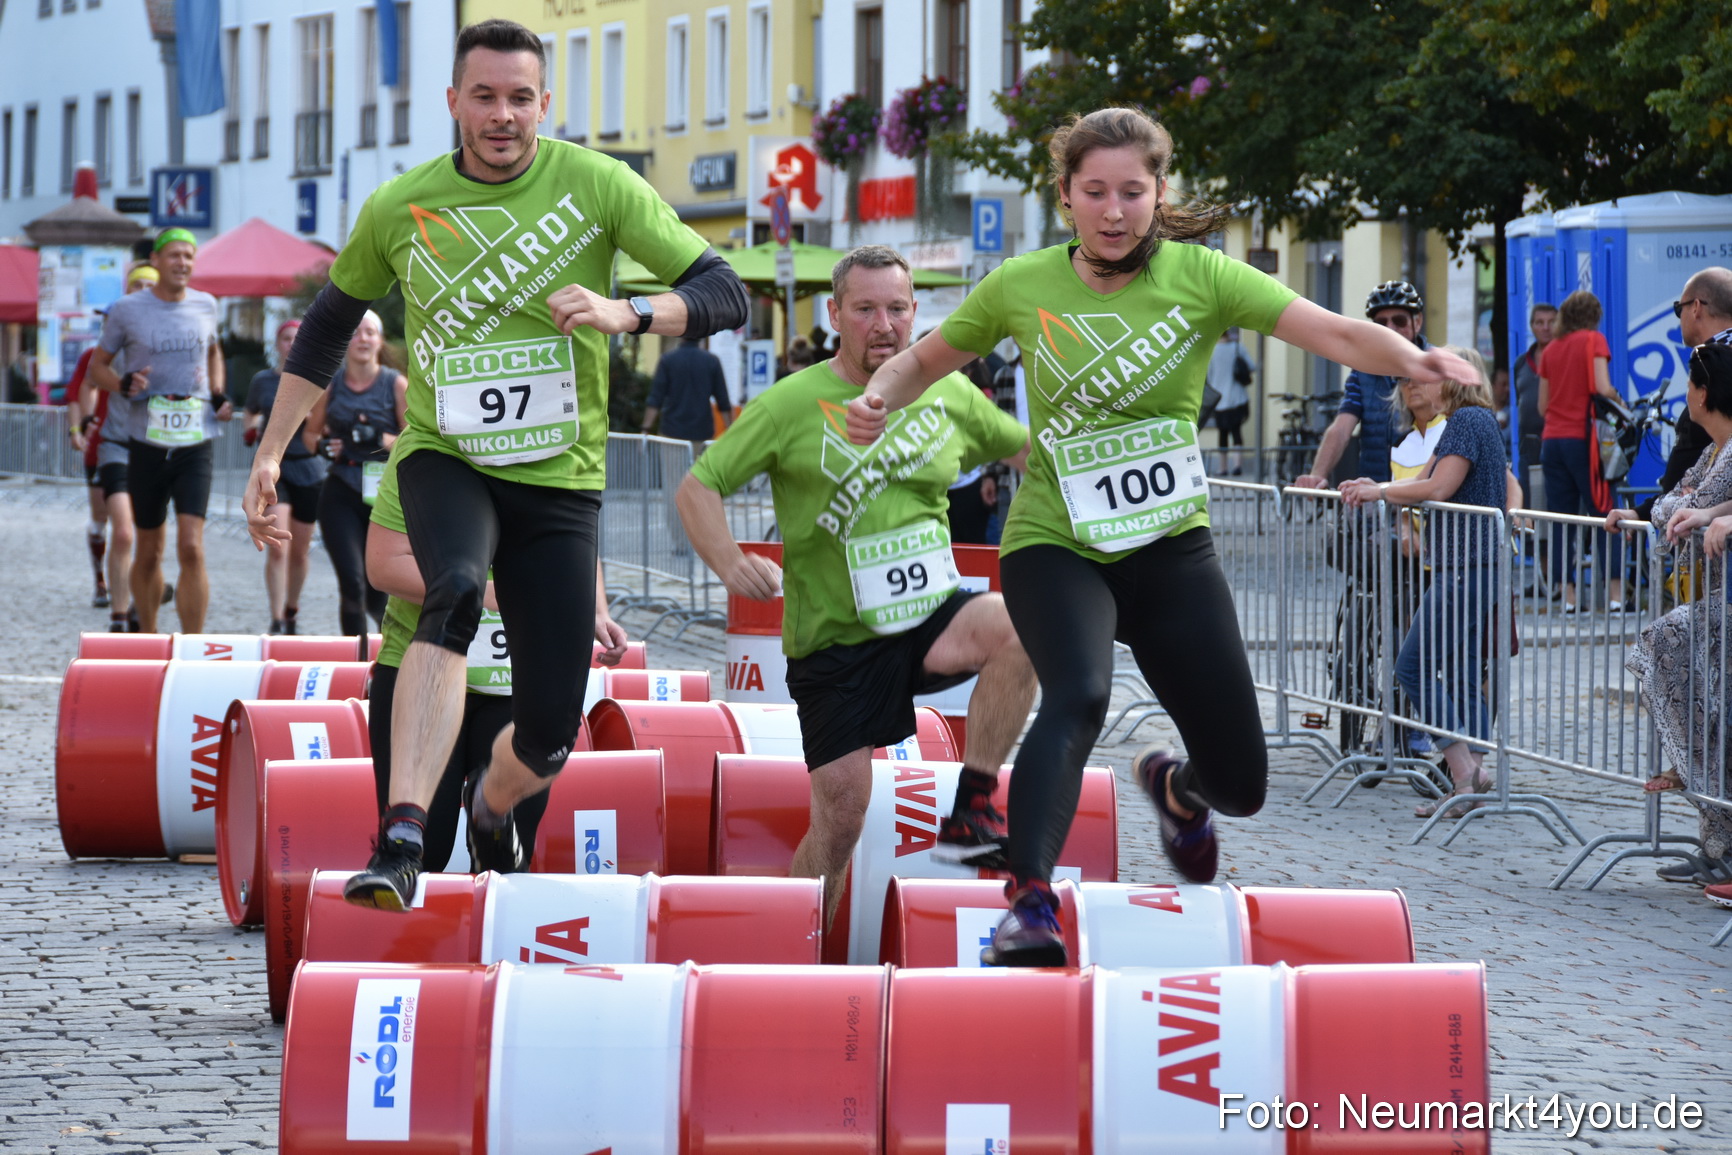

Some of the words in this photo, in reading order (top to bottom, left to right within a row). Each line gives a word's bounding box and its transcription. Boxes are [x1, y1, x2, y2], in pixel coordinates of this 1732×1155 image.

[979, 204, 997, 247] P
[1666, 244, 1707, 259] 08141
[413, 193, 584, 370] BURKHARDT
[472, 315, 500, 342] UND
[499, 223, 603, 317] GEBÄUDETECHNIK
[445, 343, 560, 380] BOCK
[1037, 305, 1191, 454] BURKHARDT
[1112, 331, 1202, 412] GEBÄUDETECHNIK
[479, 385, 531, 424] 97
[561, 381, 571, 389] E6
[161, 413, 192, 428] 107
[458, 428, 563, 453] NIKOLAUS
[1063, 420, 1185, 471] BOCK
[1186, 455, 1197, 463] E6
[816, 397, 948, 536] BURKHARDT
[1094, 461, 1176, 510] 100
[1088, 502, 1197, 540] FRANZISKA
[856, 526, 941, 566] BOCK
[886, 562, 928, 597] 99
[726, 655, 765, 691] VIA
[190, 713, 225, 813] AVIA
[893, 765, 940, 858] AVIA
[402, 996, 415, 1043] energie
[1447, 1013, 1463, 1080] 12414-B&B
[843, 1097, 858, 1128] 323
